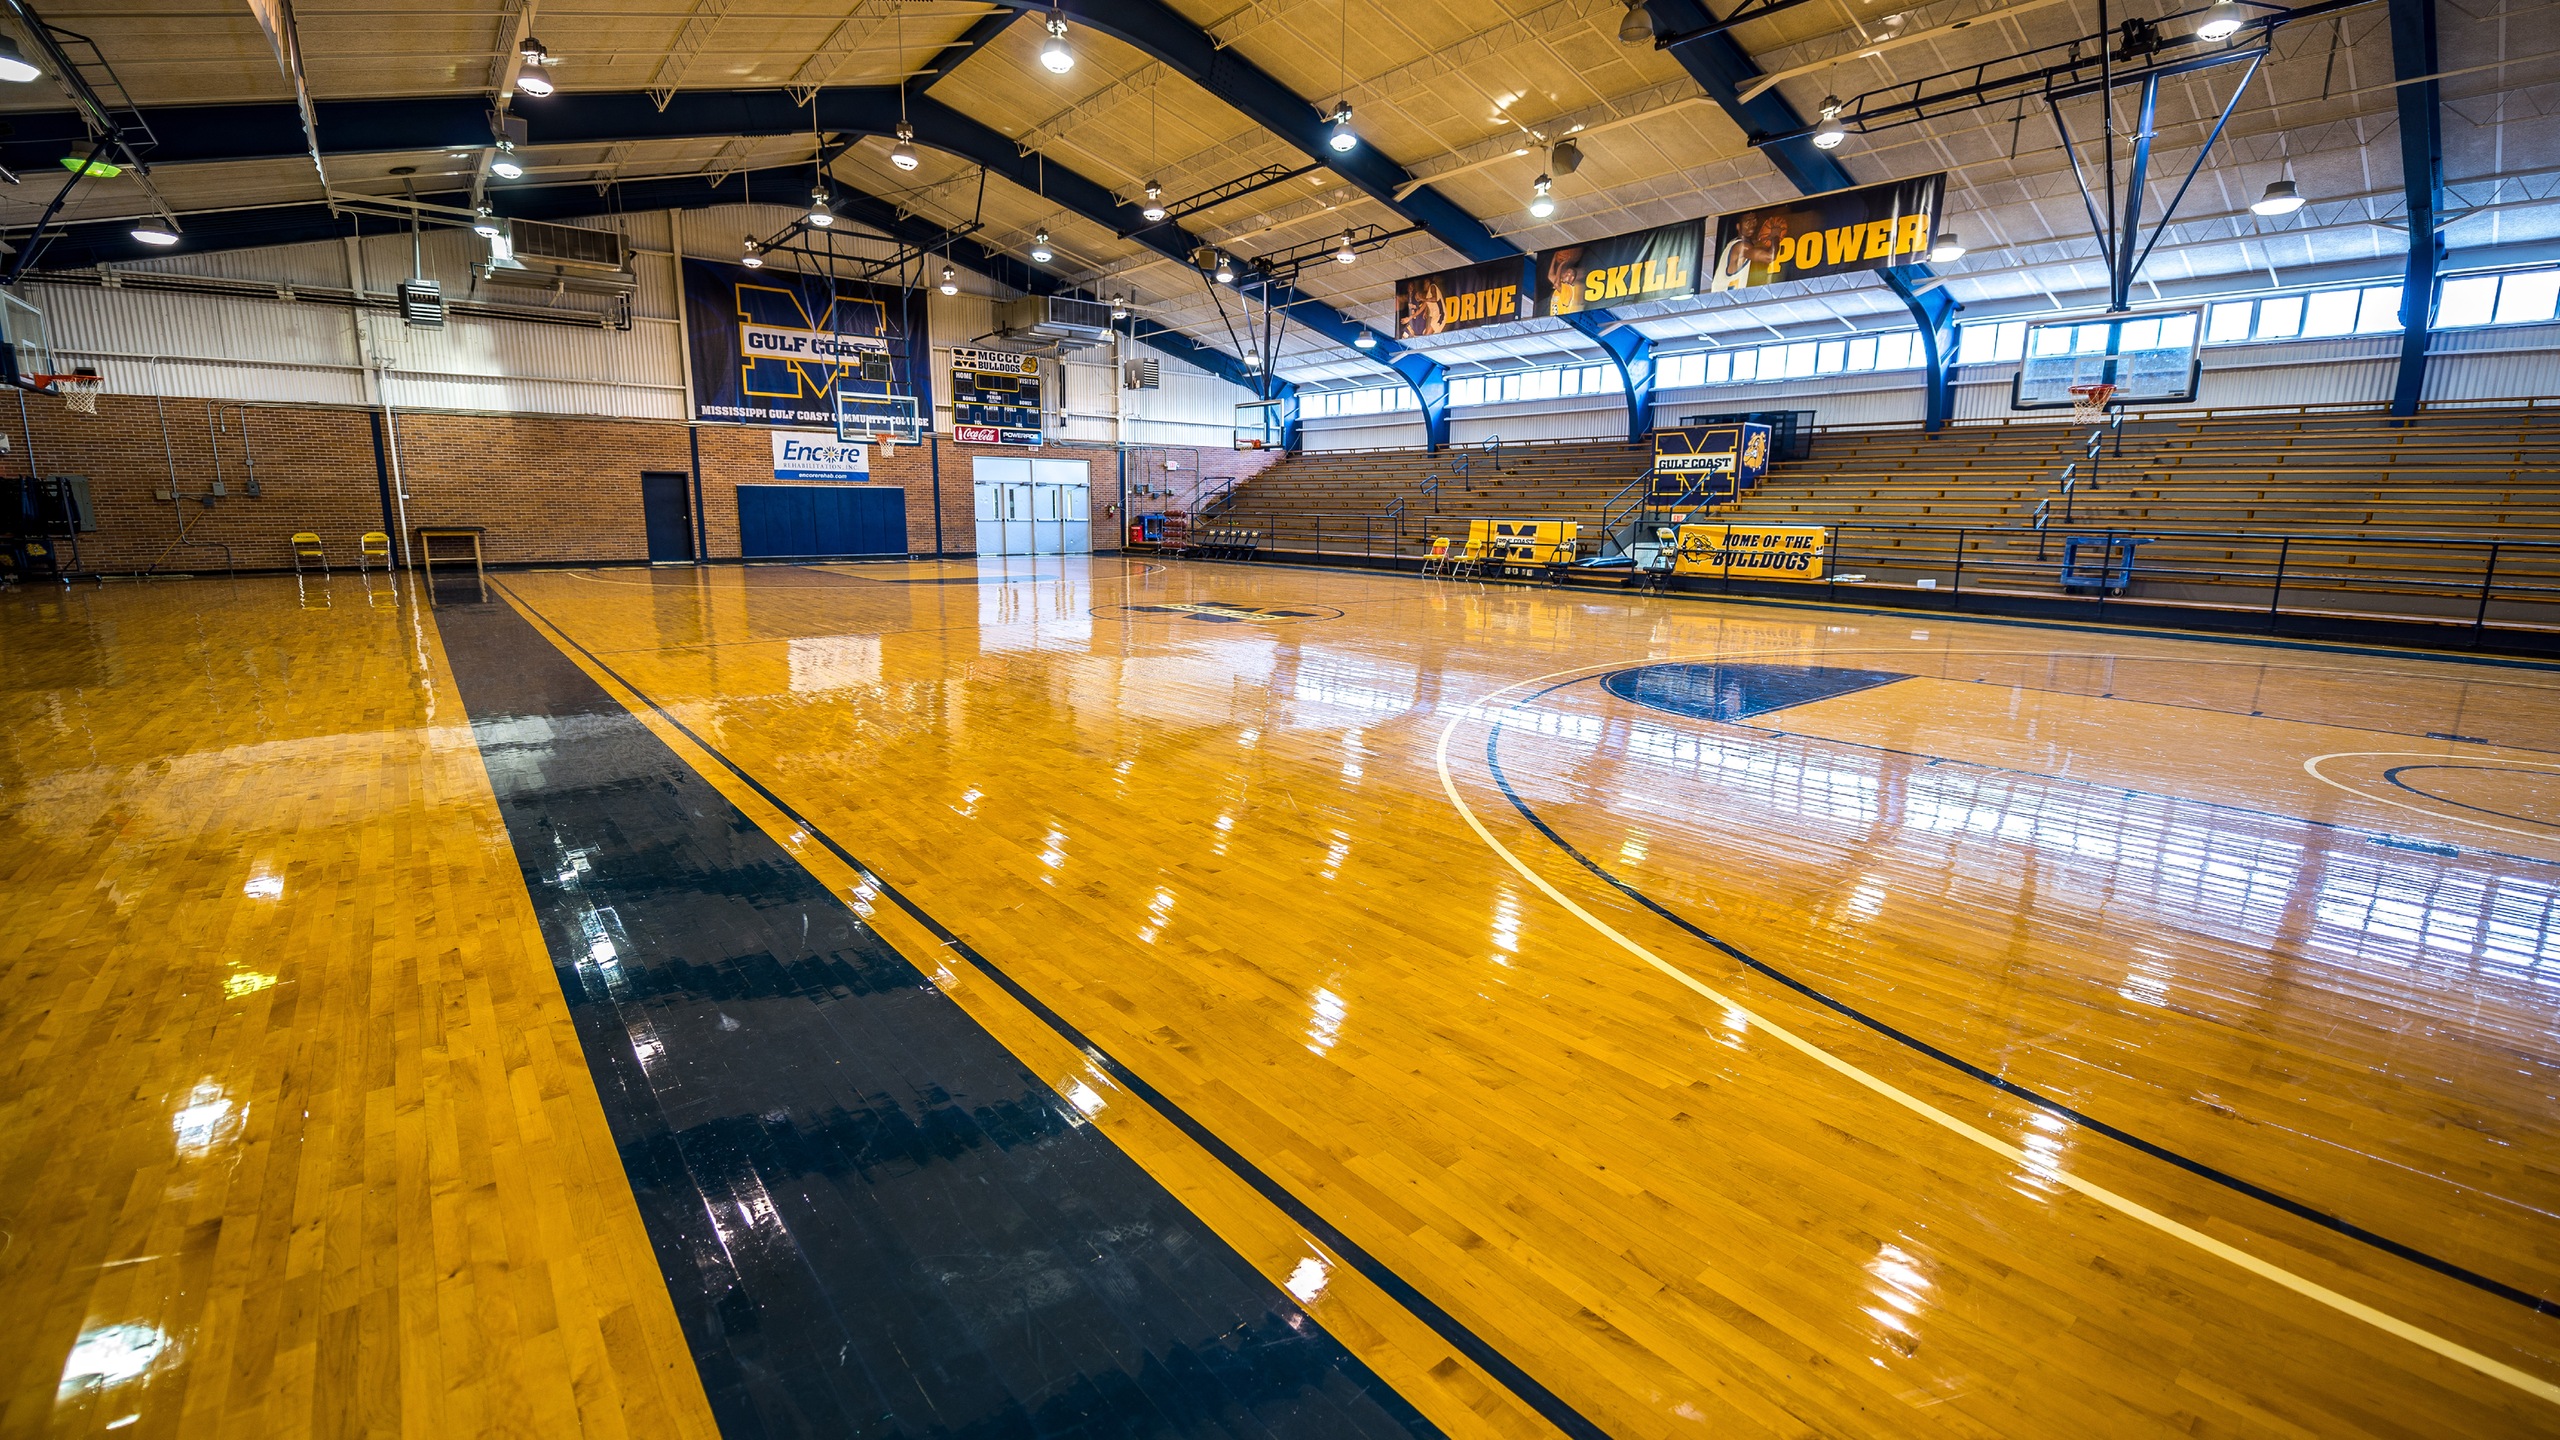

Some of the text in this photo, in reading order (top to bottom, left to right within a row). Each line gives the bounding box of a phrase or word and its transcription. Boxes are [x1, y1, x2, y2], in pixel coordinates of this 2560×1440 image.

[1767, 213, 1929, 274] POWER
[1584, 255, 1688, 302] SKILL
[1445, 284, 1517, 324] DRIVE
[748, 332, 807, 353] GULF
[978, 351, 1020, 364] MGCCC
[978, 361, 1020, 373] BULLDOGS
[1019, 378, 1039, 386] VISITOR
[701, 405, 767, 419] MISSISSIPPI
[769, 409, 795, 420] GULF
[797, 411, 829, 422] COAST
[831, 413, 888, 424] CMMUNITY
[783, 440, 860, 463] Encore
[1659, 457, 1731, 469] GULF COAST
[1722, 533, 1814, 549] HOME OF THE
[1711, 550, 1812, 571] BULLDOGS
